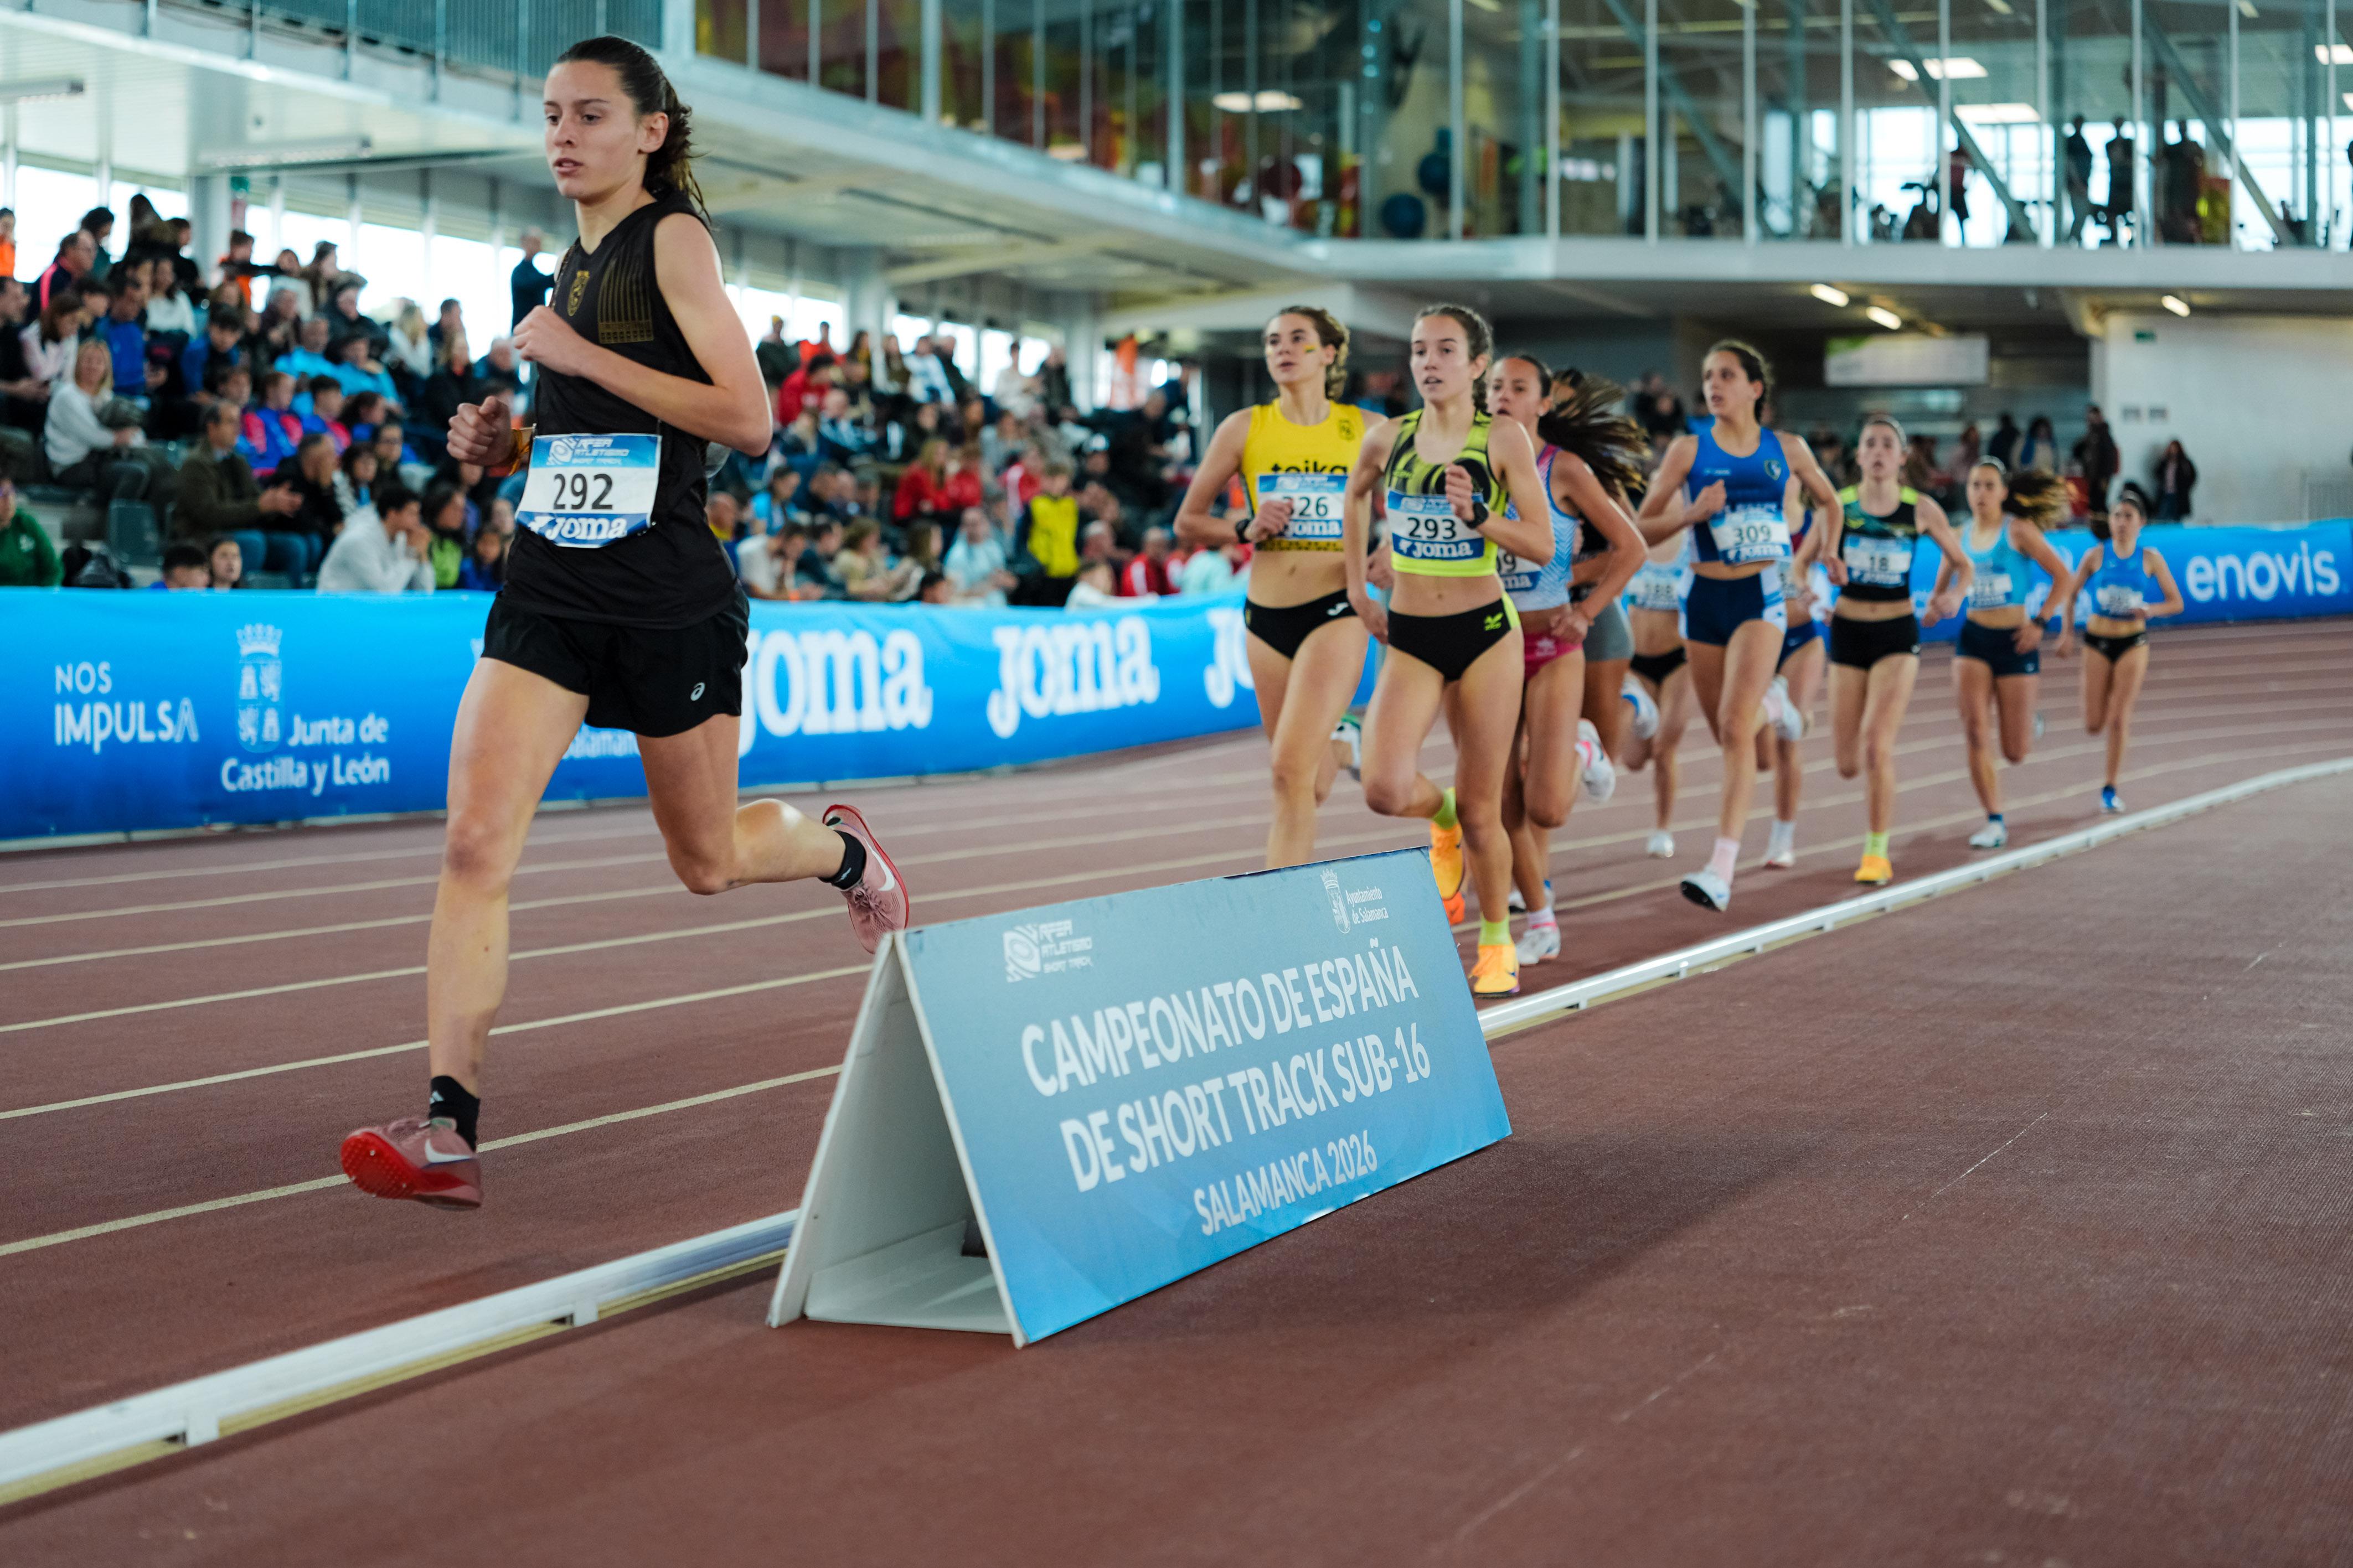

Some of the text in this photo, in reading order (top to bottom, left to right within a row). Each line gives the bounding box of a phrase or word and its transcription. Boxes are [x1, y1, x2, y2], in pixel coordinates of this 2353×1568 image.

[553, 473, 613, 510] 292
[1283, 496, 1329, 516] 26
[1407, 517, 1457, 540] 293
[1733, 525, 1771, 546] 309
[2186, 540, 2340, 602] enovis
[55, 661, 112, 694] NOS
[55, 697, 199, 754] IMPULSA
[288, 712, 388, 746] Junta de
[221, 752, 389, 796] Castilla y León
[1345, 886, 1382, 908] Ayuntamiento
[1352, 907, 1389, 924] de Salamanca
[1021, 937, 1420, 1097] CAMPEONATO DE ESPAÑA
[1060, 1022, 1431, 1193] DE SHORT TRACK SUB-16
[1194, 1129, 1377, 1236] SALAMANCA 2026
